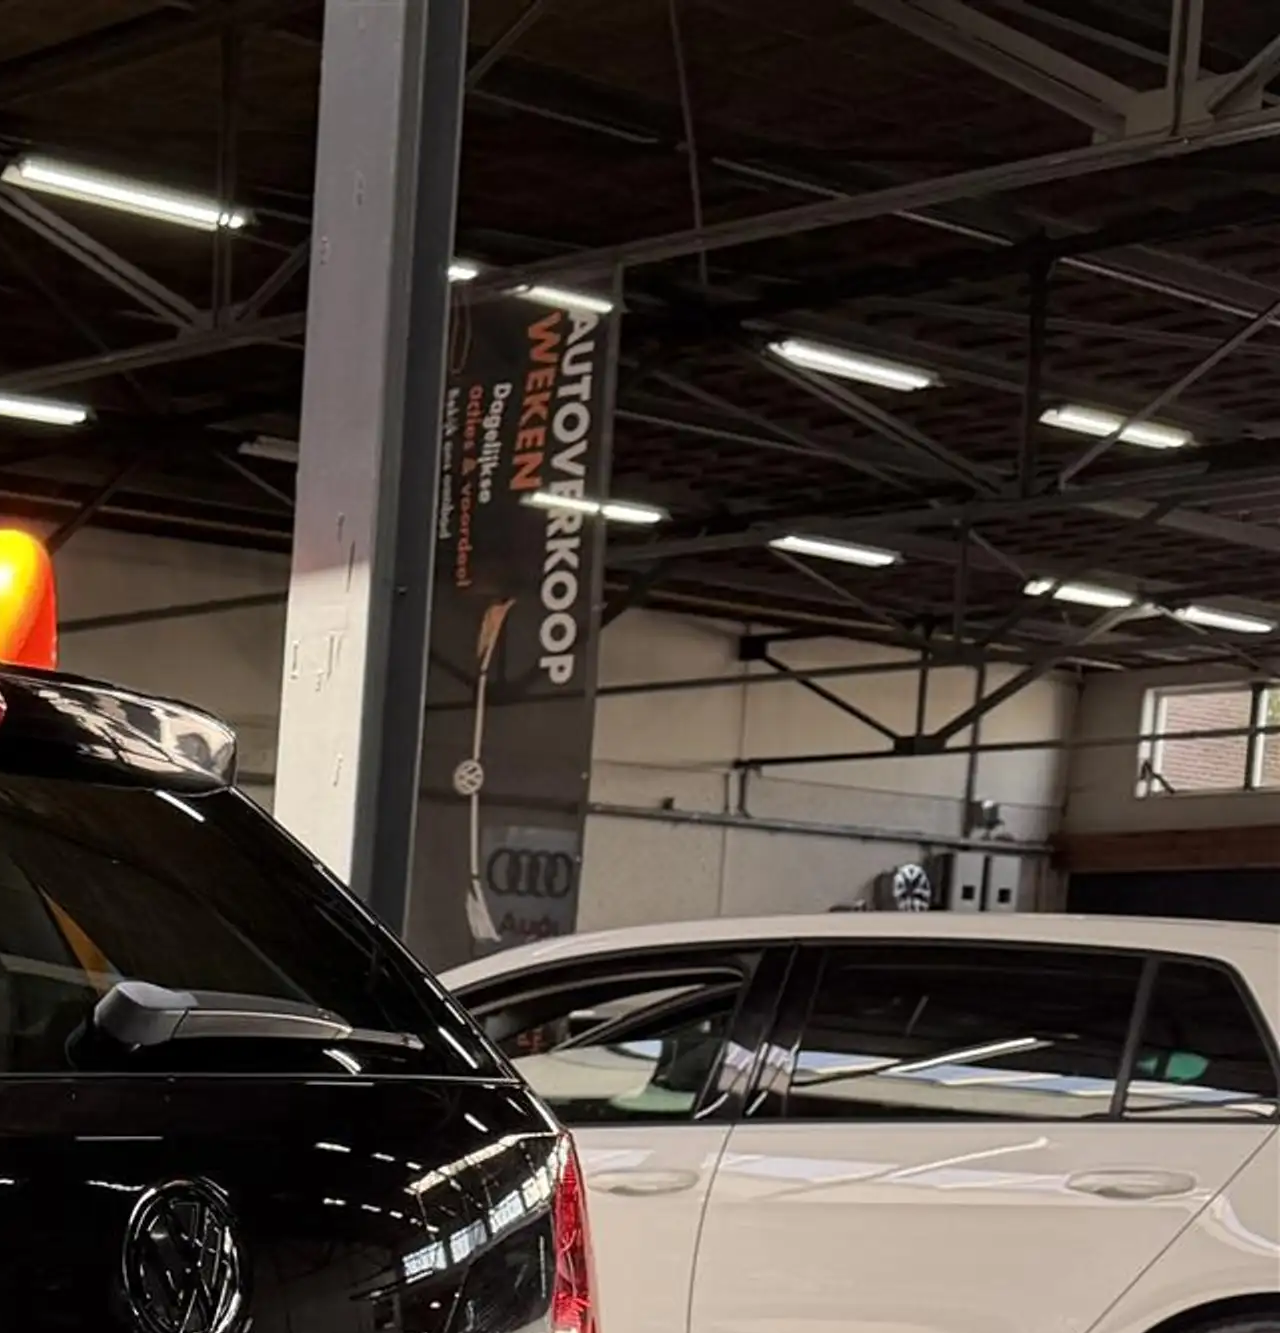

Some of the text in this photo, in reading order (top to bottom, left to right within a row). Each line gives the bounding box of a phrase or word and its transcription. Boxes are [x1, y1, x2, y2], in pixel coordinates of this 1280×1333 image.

[477, 382, 513, 504] Dagelijkse
[510, 310, 563, 490] WEKEN
[539, 308, 599, 685] AUTOVERKOOP
